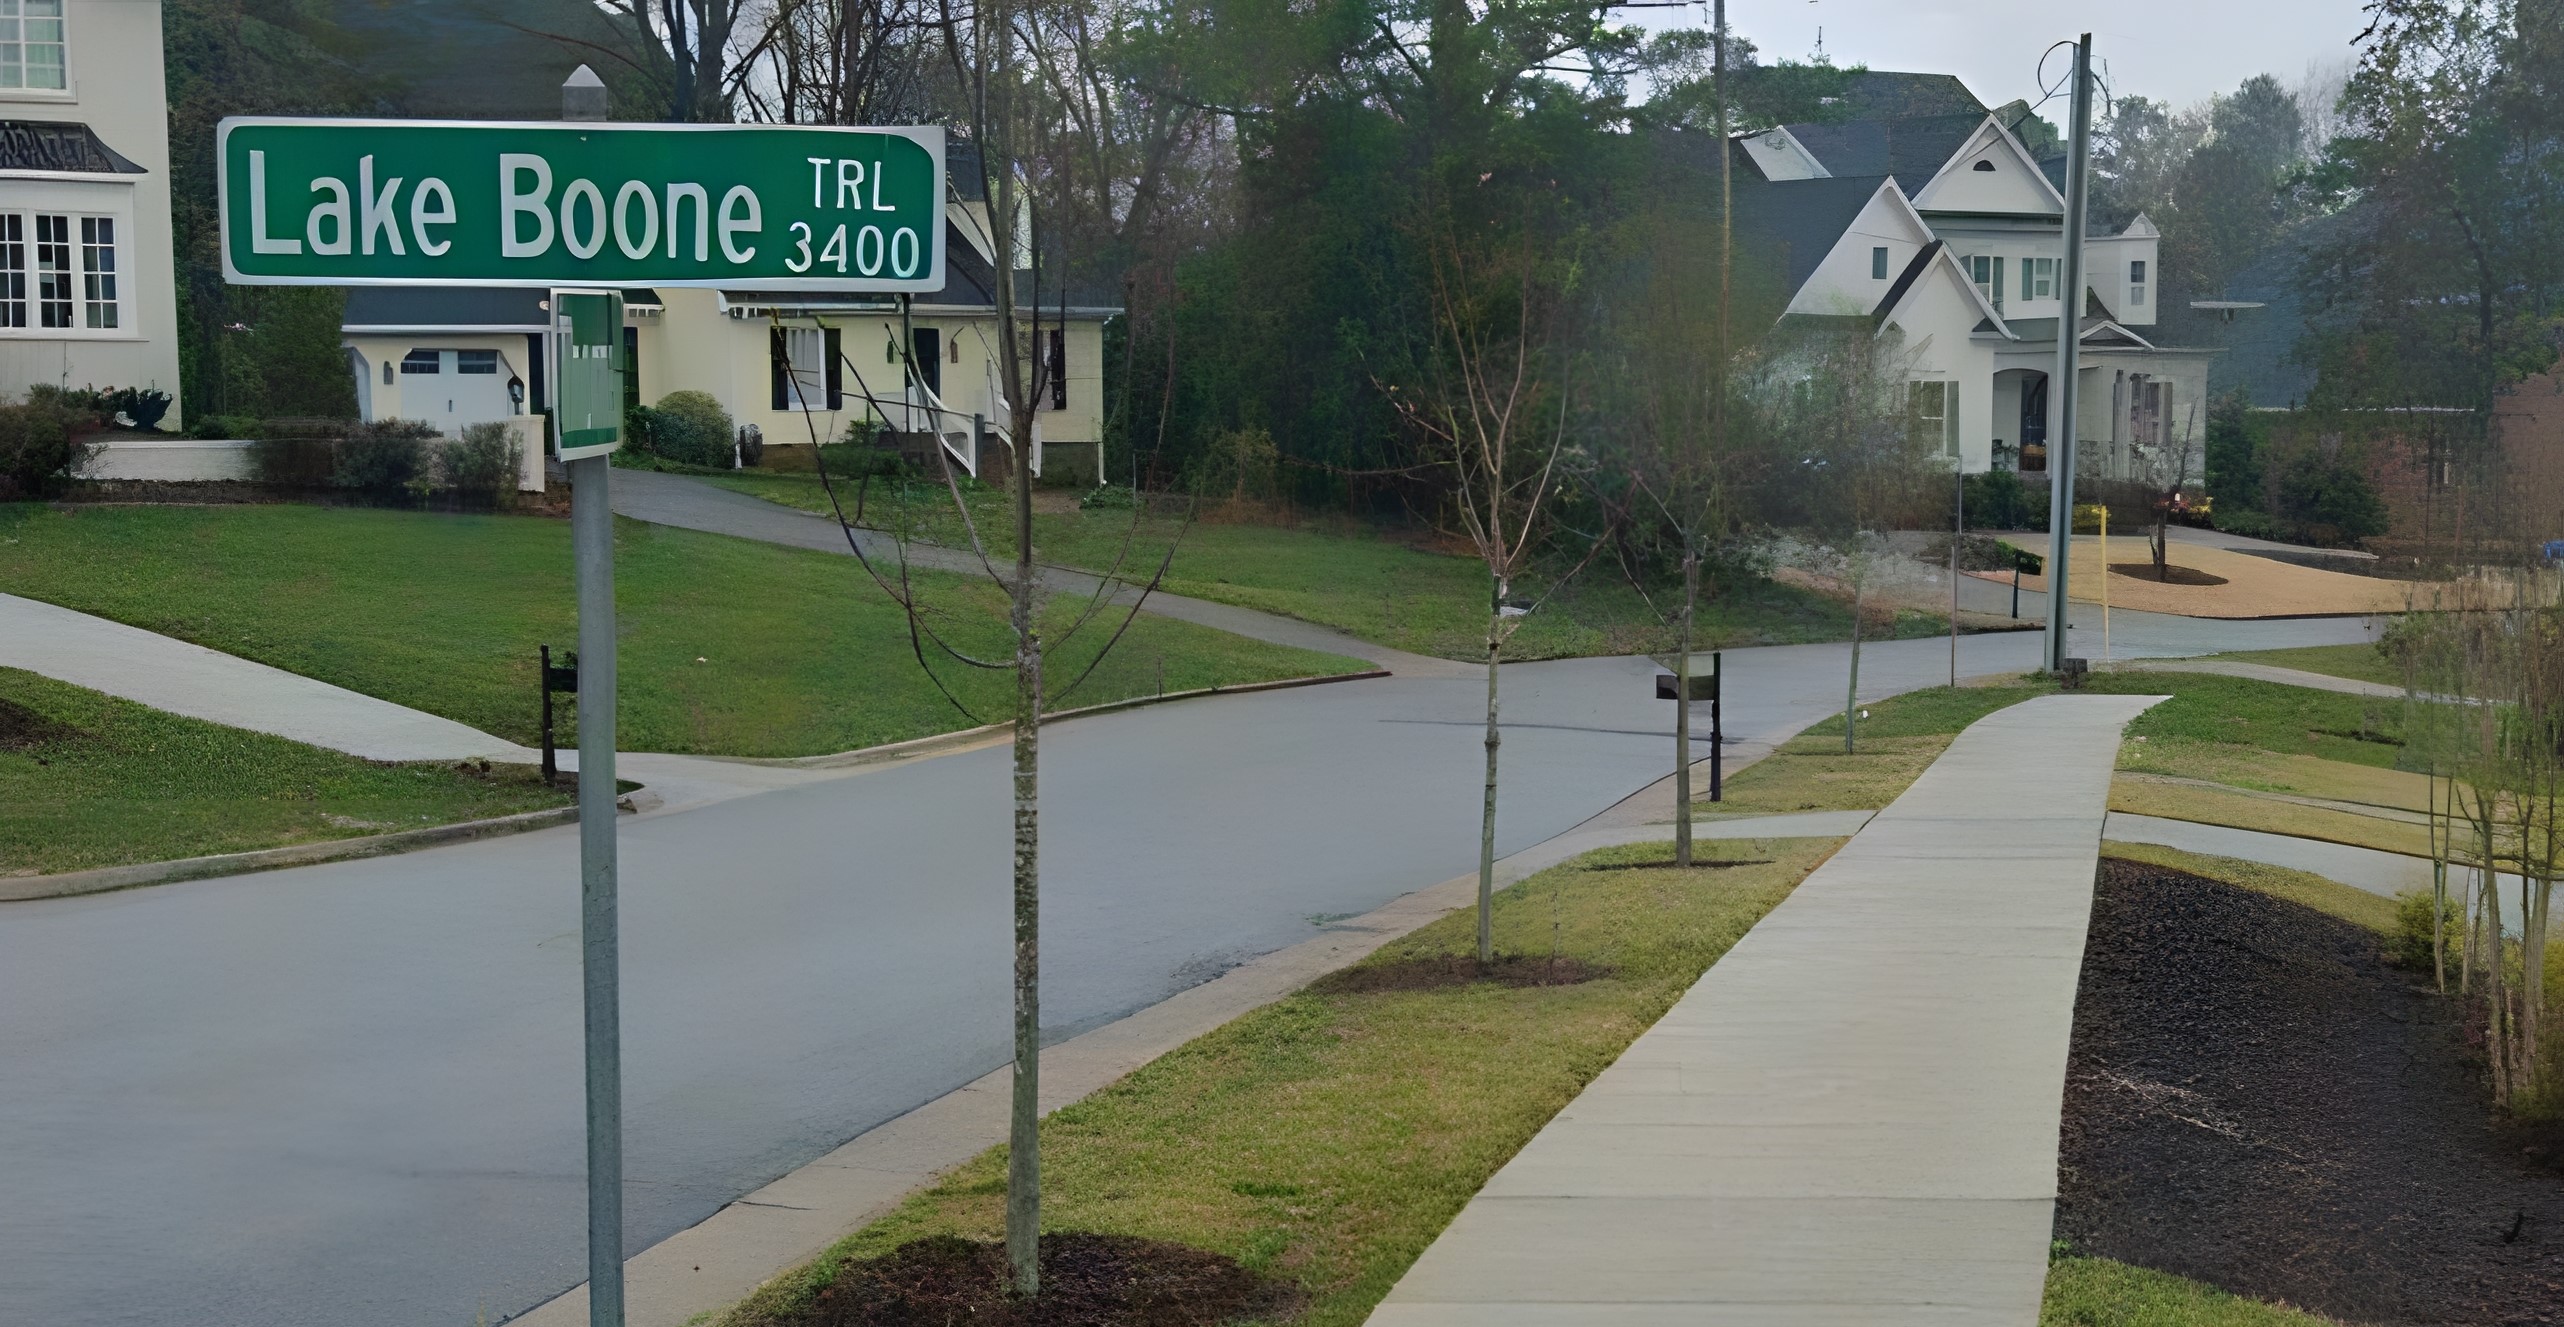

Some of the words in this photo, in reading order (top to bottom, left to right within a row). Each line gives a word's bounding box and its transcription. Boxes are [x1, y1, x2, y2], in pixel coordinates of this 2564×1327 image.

[248, 150, 457, 257] Lake
[499, 153, 763, 264] Boone
[807, 157, 896, 212] TRL
[784, 221, 921, 280] 3400
